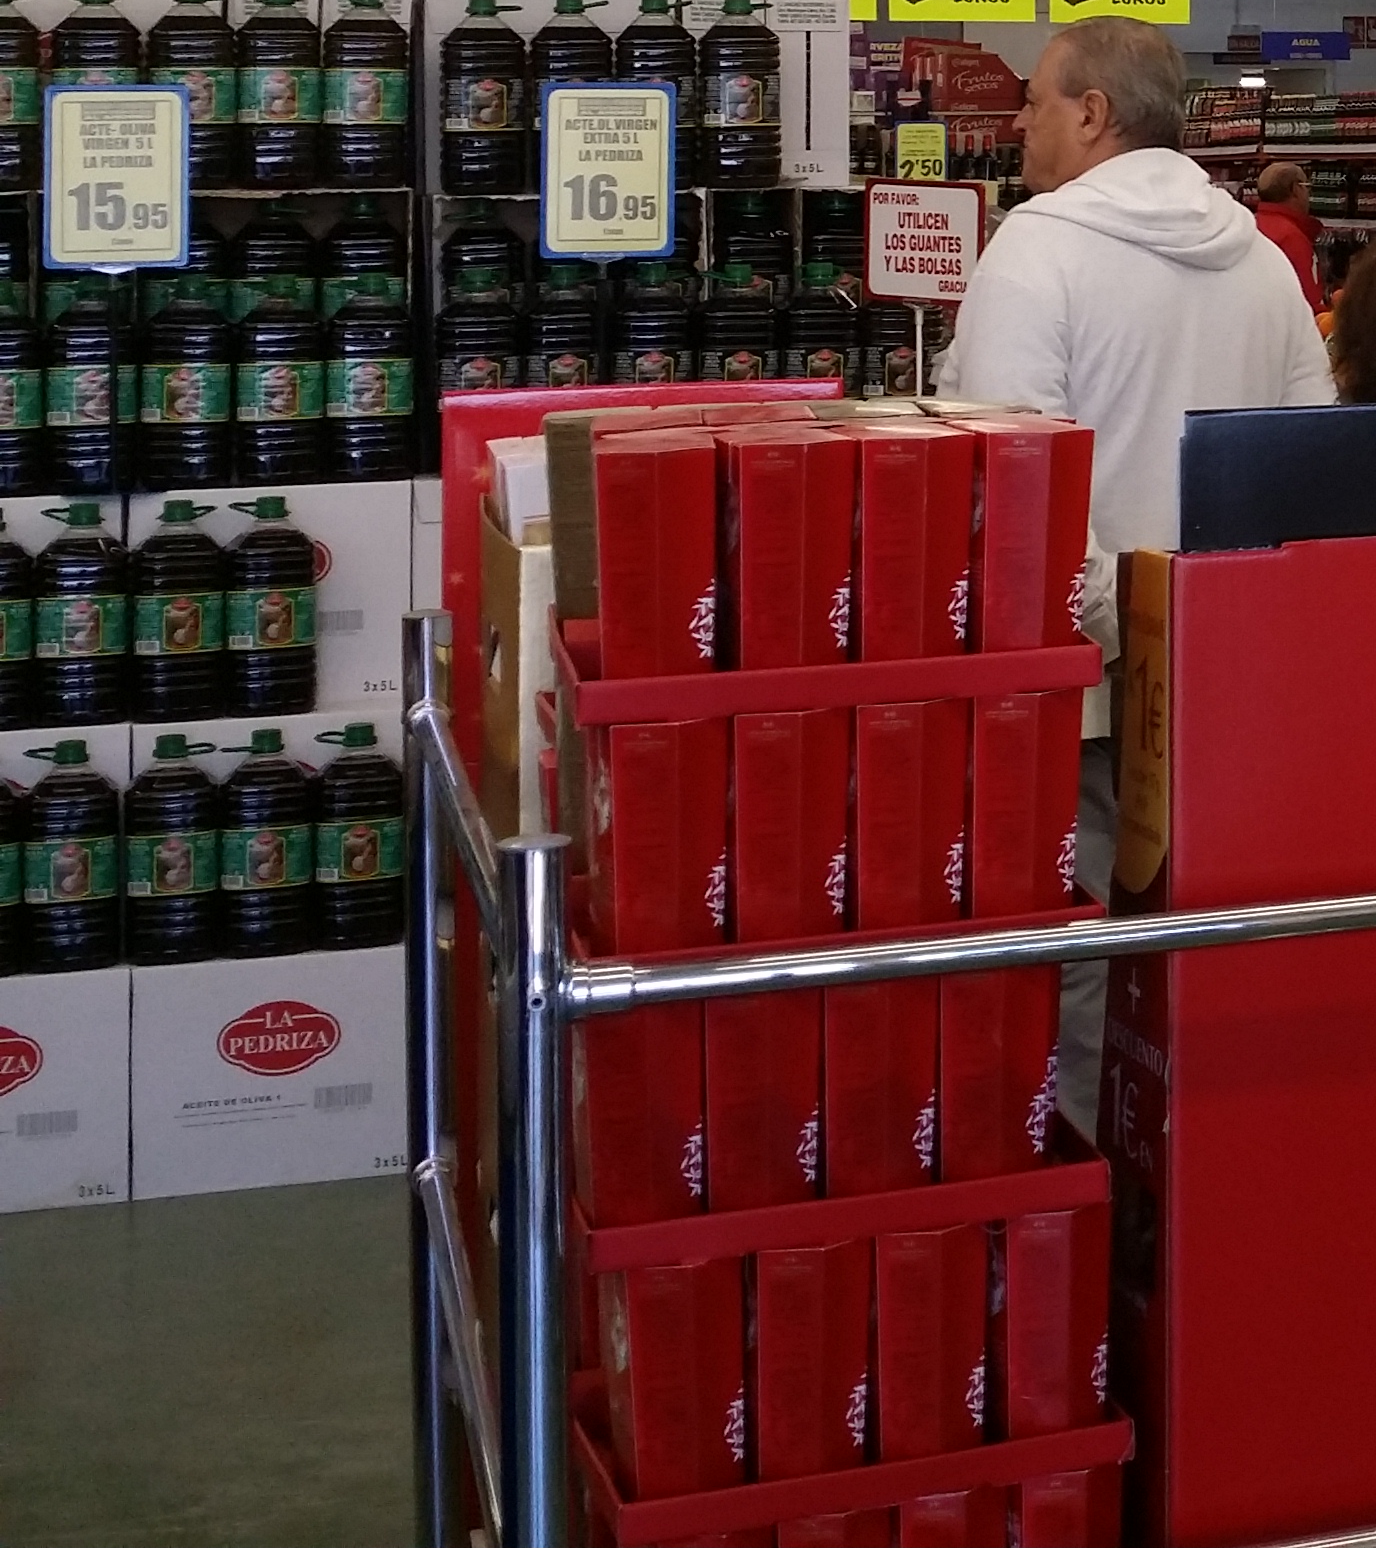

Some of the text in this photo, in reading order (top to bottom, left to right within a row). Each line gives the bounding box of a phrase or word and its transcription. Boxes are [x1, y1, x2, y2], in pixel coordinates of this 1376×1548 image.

[136, 139, 143, 149] 5
[584, 133, 638, 144] EXTRA 5 L
[83, 156, 152, 168] LA PEDRIZA
[579, 150, 643, 161] LA PEDRIZA
[873, 193, 919, 205] POR FAVOR:
[898, 212, 948, 230] UTILICEN
[885, 233, 961, 253] LOS GUANTES
[885, 255, 961, 275] Y LAS BOLSAS
[939, 280, 967, 293] GRACI
[265, 1012, 294, 1028] LA
[229, 1030, 329, 1055] PEDRIZA
